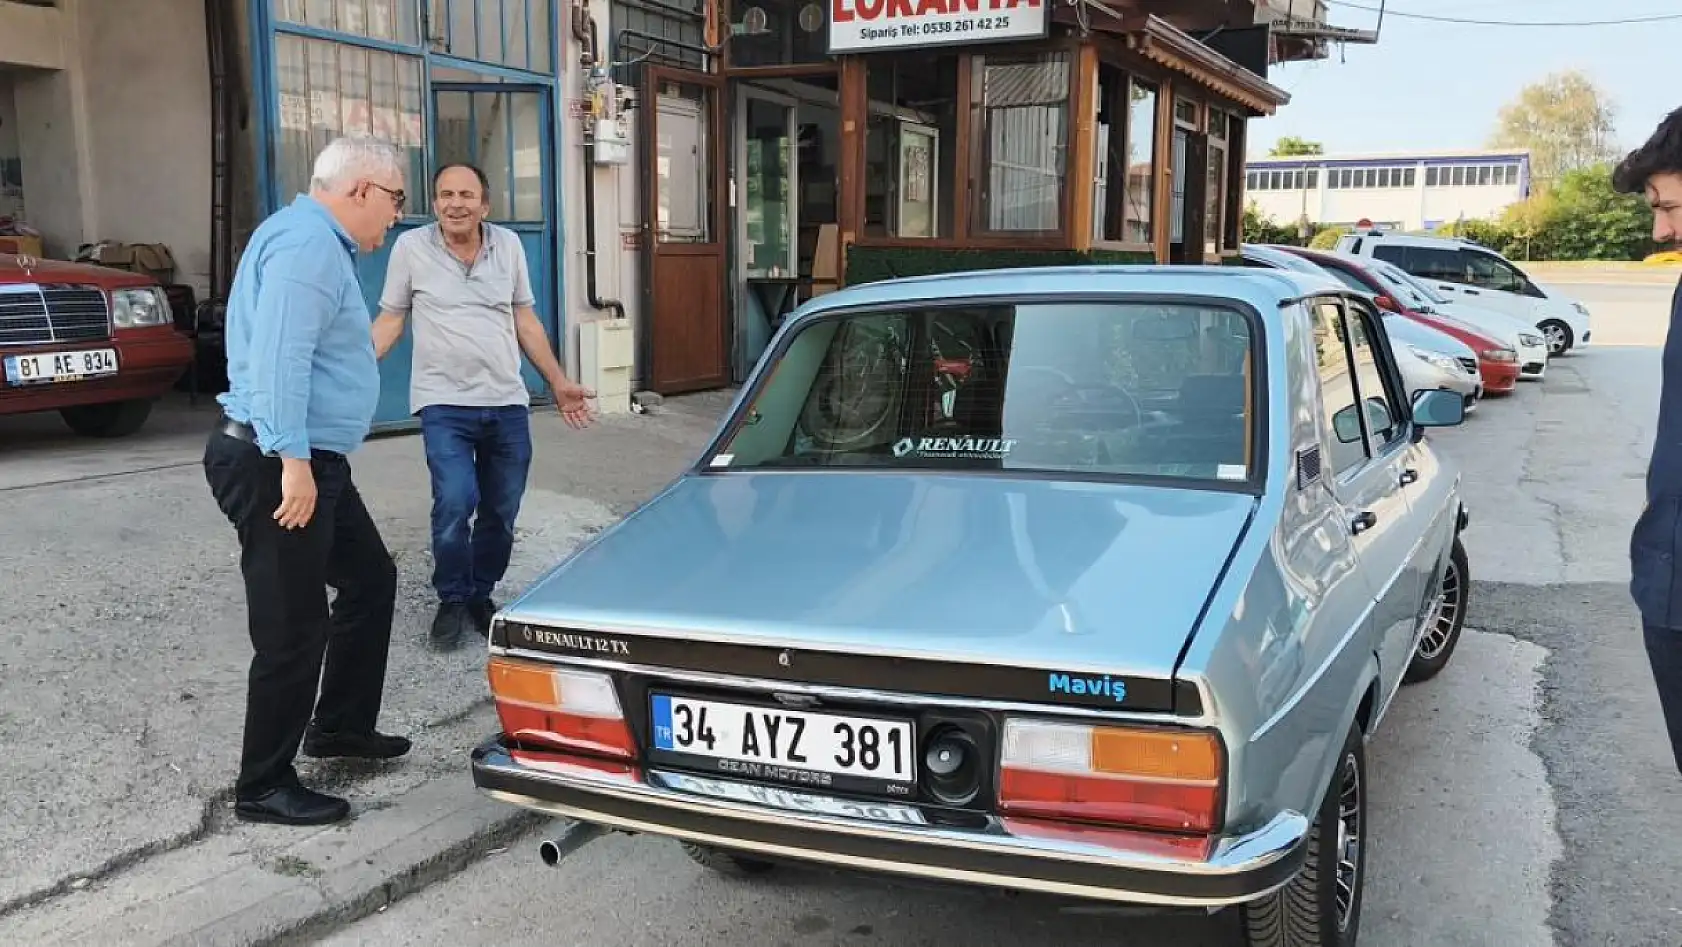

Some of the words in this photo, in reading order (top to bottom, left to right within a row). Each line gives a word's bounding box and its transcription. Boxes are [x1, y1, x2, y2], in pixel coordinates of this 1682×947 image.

[833, 0, 1041, 22] LOKA
[861, 26, 898, 40] Sipariş
[900, 22, 920, 36] Tel:
[923, 21, 952, 34] 0538
[955, 19, 974, 32] 261
[977, 17, 993, 30] 42
[994, 16, 1010, 28] 25
[20, 358, 40, 376] 81
[54, 354, 75, 374] AE
[84, 351, 113, 371] 834
[917, 436, 1015, 452] RENAULT
[535, 629, 593, 650] RENAULT
[595, 638, 609, 652] 12
[610, 639, 630, 655] TX
[1049, 672, 1126, 702] Maviş
[656, 725, 672, 741] TR
[673, 703, 716, 750] 34
[741, 711, 807, 763] AYZ
[833, 721, 903, 774] 381
[763, 764, 833, 786] MOTORS
